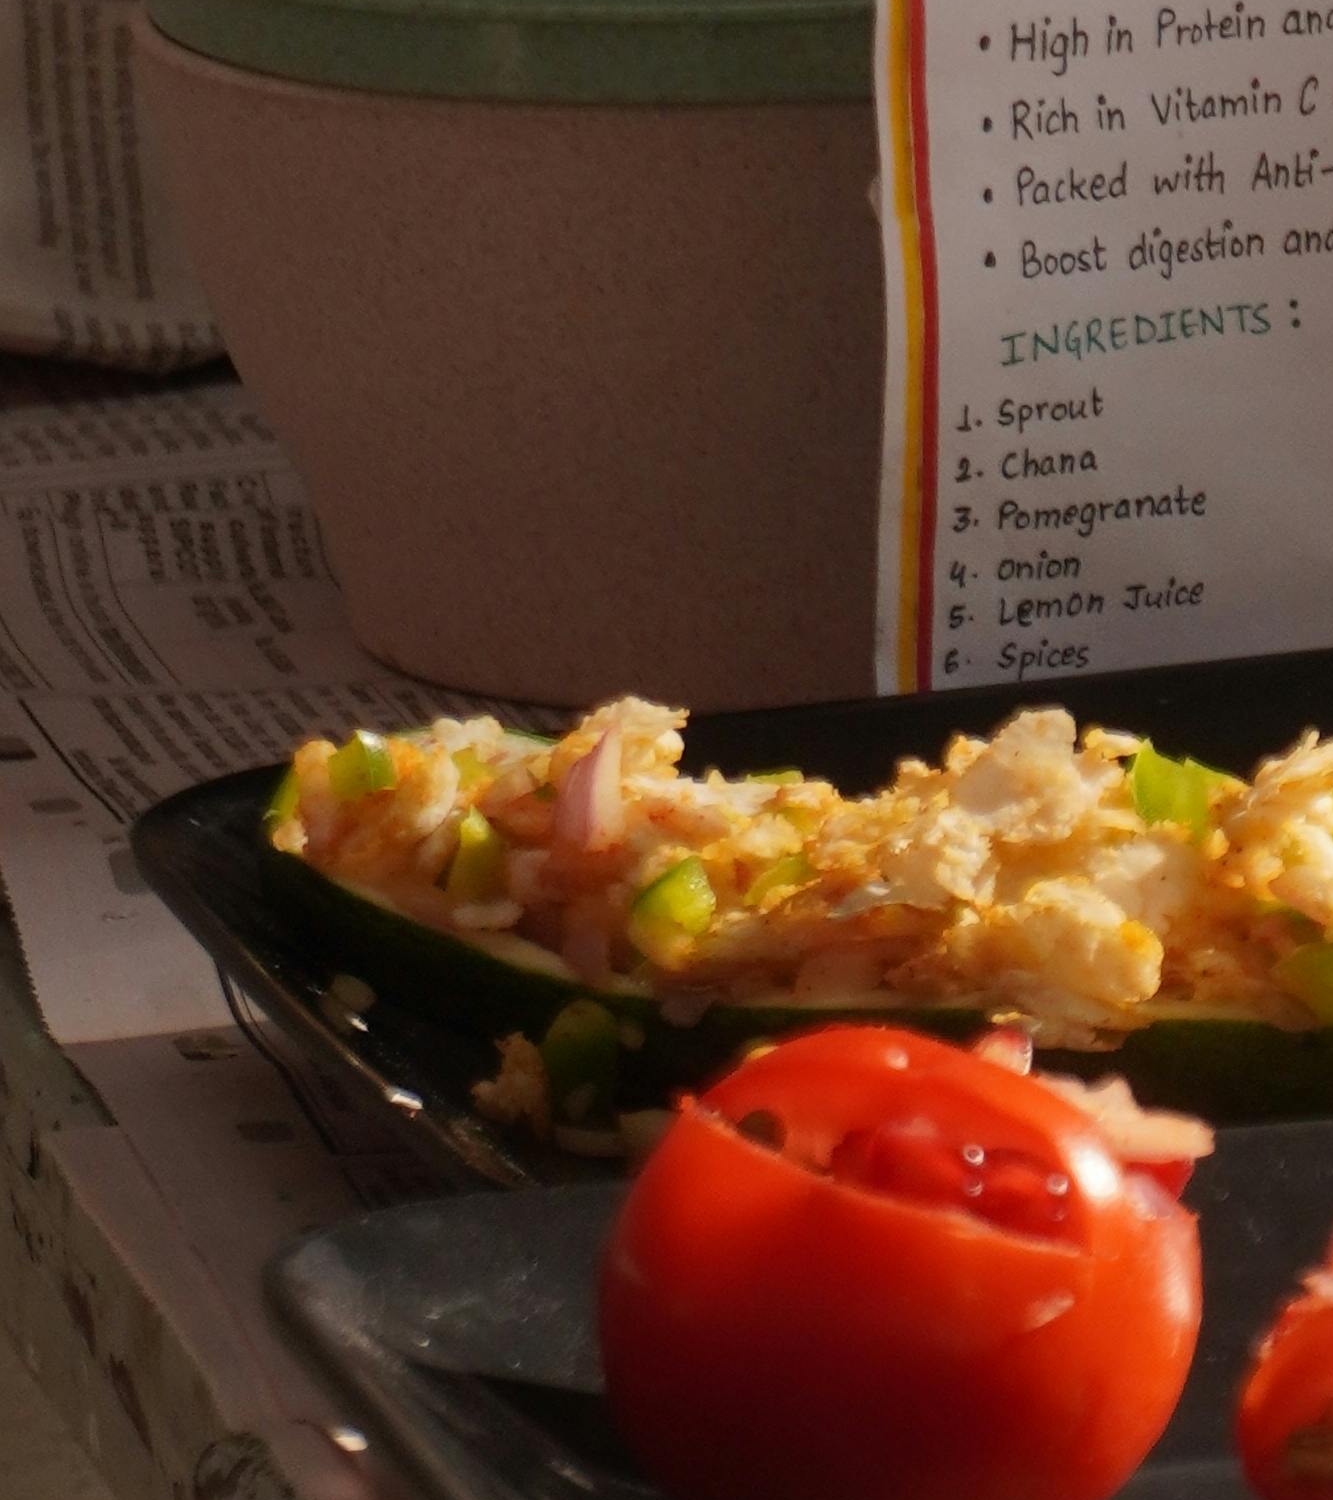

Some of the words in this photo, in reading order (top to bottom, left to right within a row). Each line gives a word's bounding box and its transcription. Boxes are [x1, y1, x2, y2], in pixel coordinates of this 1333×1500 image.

[1010, 16, 1089, 77] High
[1106, 14, 1133, 55] in
[1156, 1, 1265, 48] Protein
[1011, 97, 1079, 140] Rich
[1097, 94, 1125, 131] in
[1150, 86, 1282, 125] Vitamin
[1298, 74, 1319, 116] C
[1016, 161, 1127, 206] Packed
[1153, 151, 1225, 195] with
[1021, 236, 1107, 279] Boost
[1128, 219, 1265, 280] digestion
[997, 387, 1103, 434] Sprout
[1001, 448, 1098, 480] Chana
[997, 484, 1207, 538] Pomegranate
[998, 592, 1105, 627] Lemon
[1123, 576, 1204, 611] Juice
[997, 639, 1089, 669] Spices
